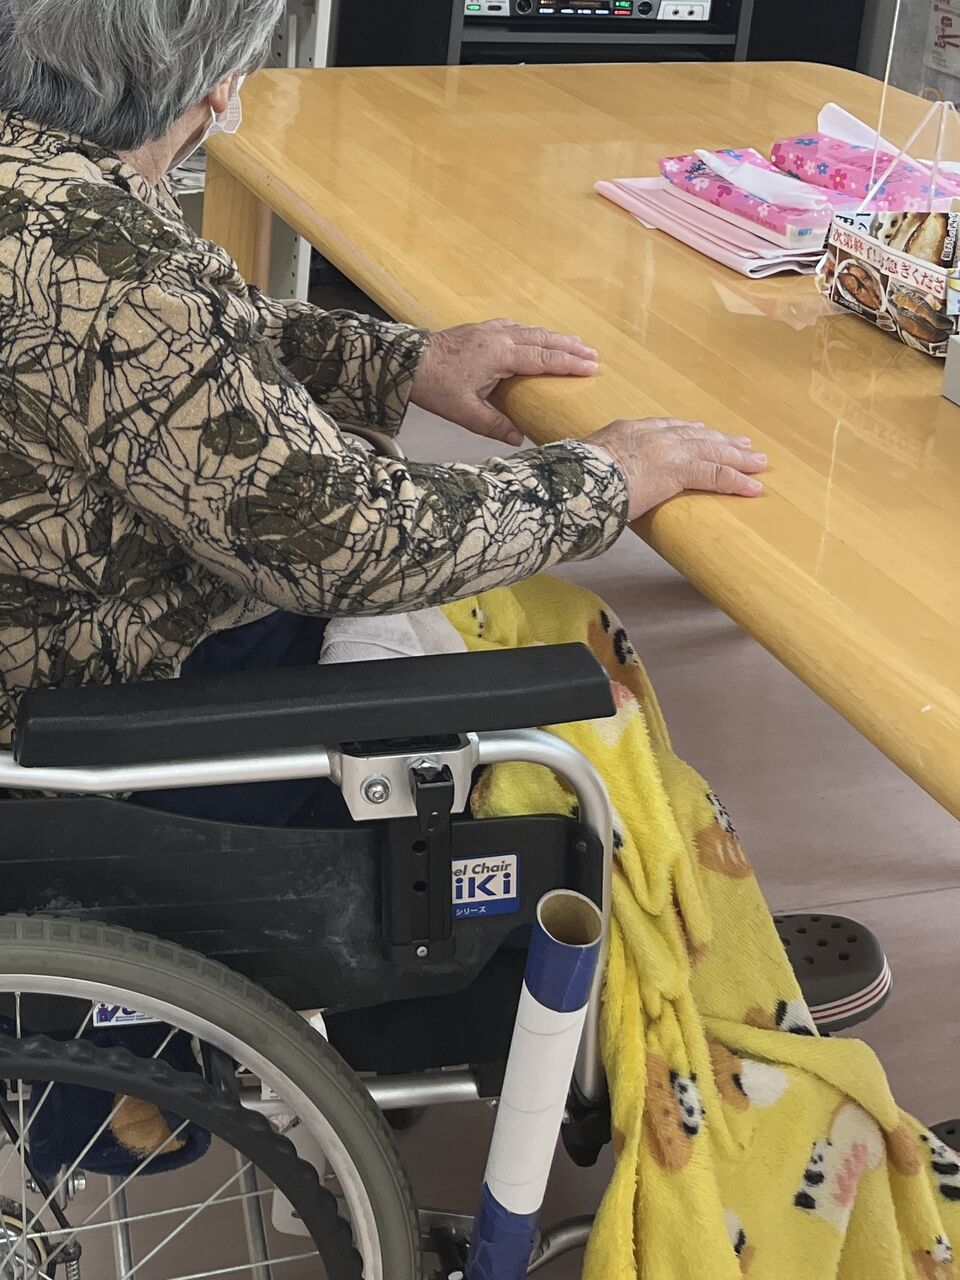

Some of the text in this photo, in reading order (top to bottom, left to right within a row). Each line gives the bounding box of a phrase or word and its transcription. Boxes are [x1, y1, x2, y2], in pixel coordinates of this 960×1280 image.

[471, 861, 512, 874] Chair
[455, 906, 486, 916] シリーズ
